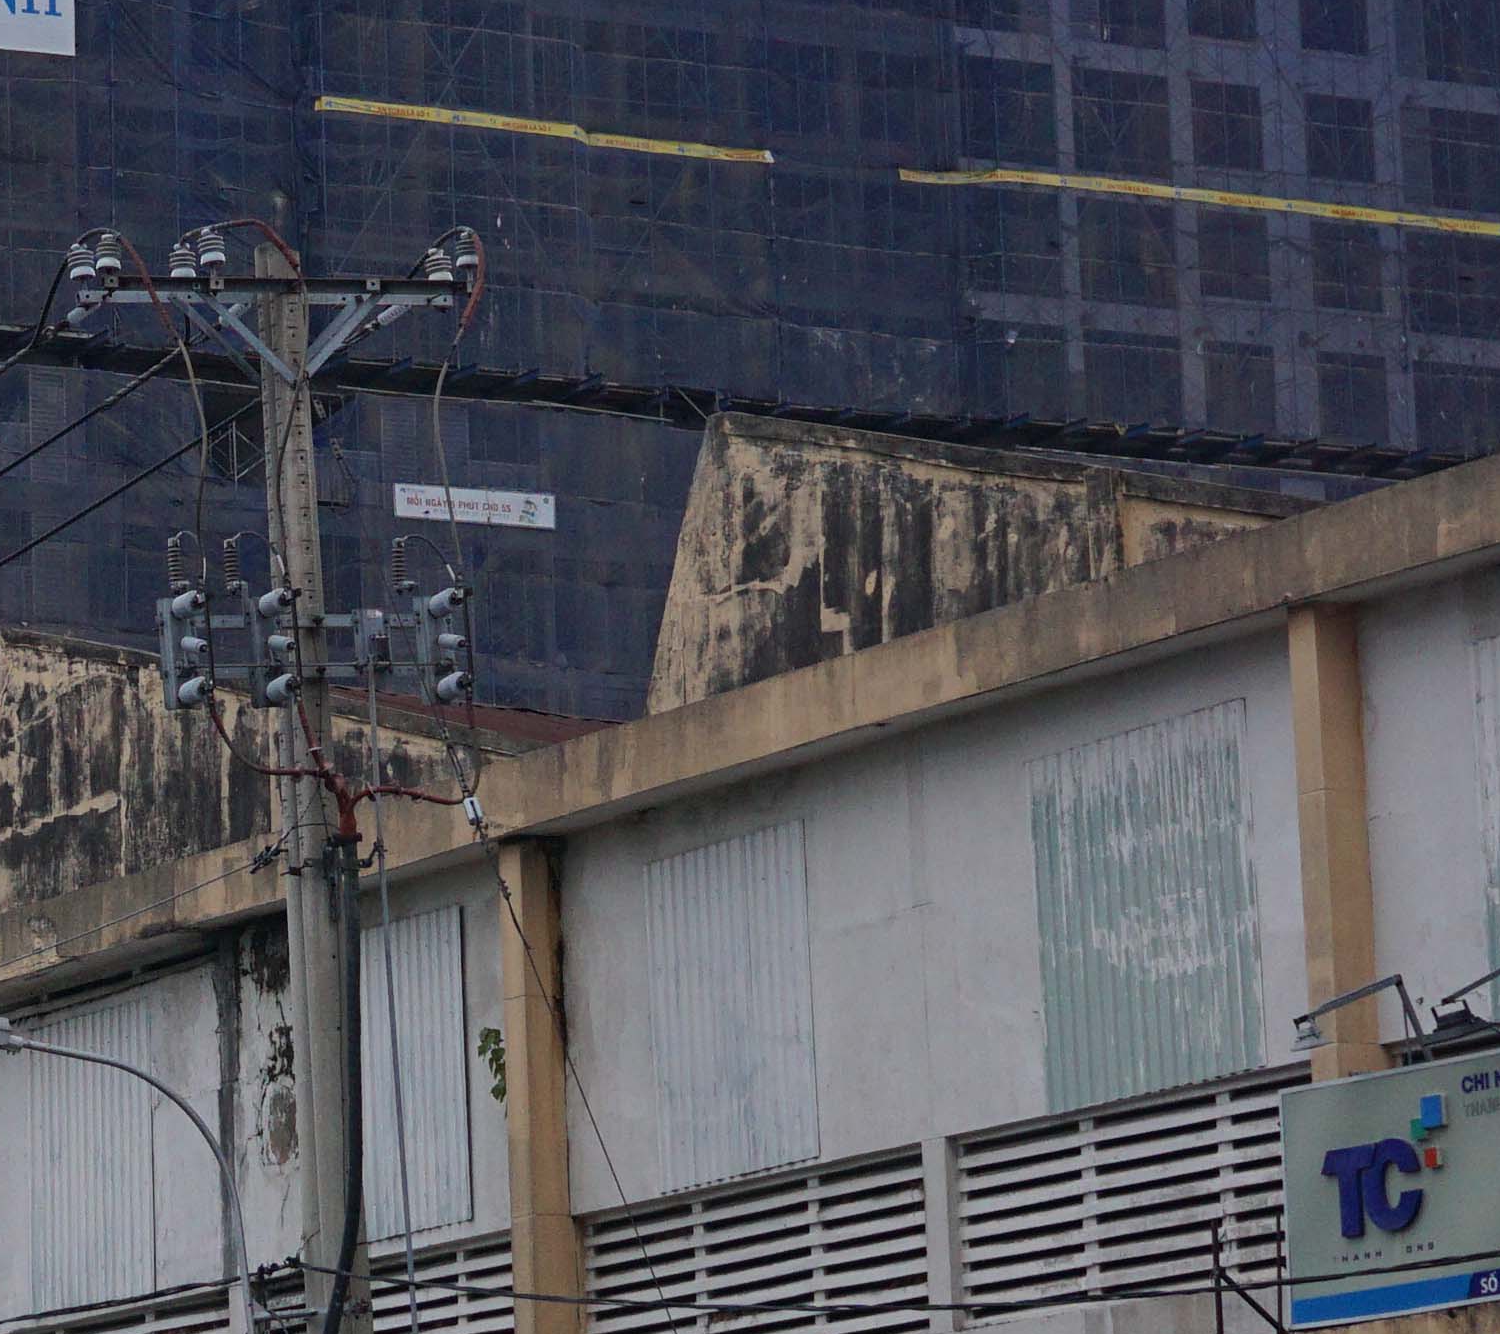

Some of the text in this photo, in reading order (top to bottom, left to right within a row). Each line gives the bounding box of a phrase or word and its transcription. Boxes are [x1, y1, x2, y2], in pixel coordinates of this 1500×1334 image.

[1461, 1073, 1490, 1094] CHI
[1321, 1138, 1424, 1239] TC
[1480, 1272, 1498, 1294] SỐ
